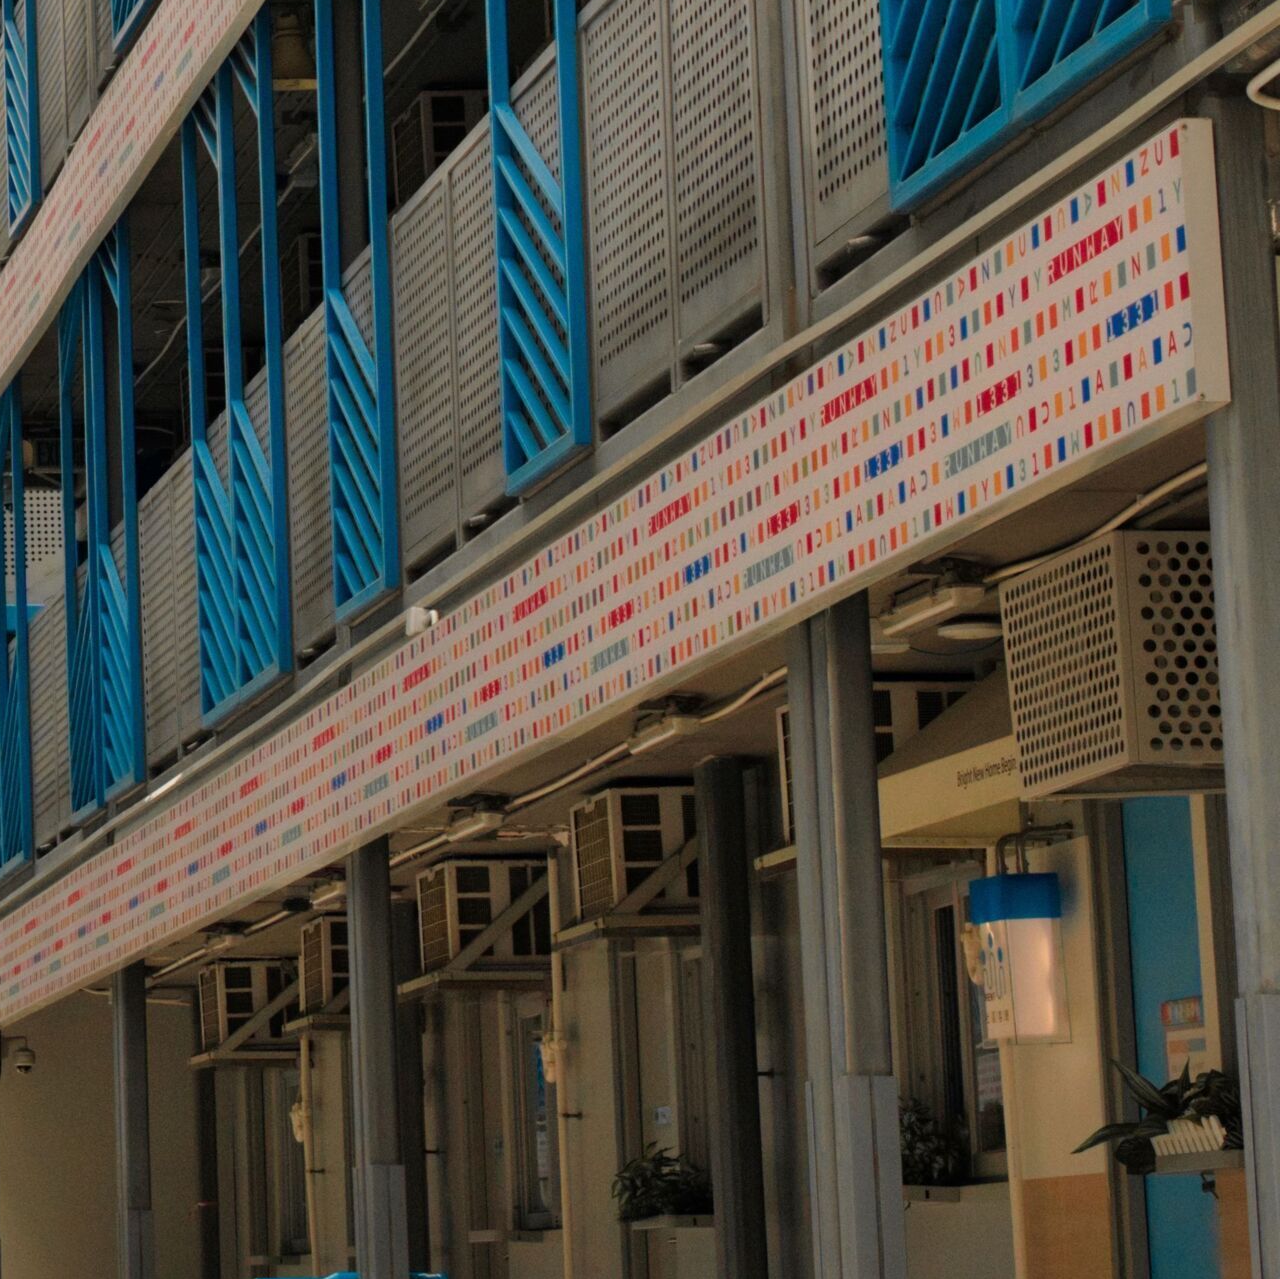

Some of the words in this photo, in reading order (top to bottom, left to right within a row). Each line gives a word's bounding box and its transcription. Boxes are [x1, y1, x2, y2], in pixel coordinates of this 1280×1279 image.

[511, 585, 548, 624] RUNWAY
[648, 491, 691, 537] RUNWAY
[819, 373, 877, 429] RUNWAY
[1046, 214, 1123, 286] RUNWAY
[682, 552, 712, 588] 1331
[767, 499, 801, 539] 1331
[864, 440, 903, 484] 1331
[976, 369, 1021, 417] 1331
[1106, 288, 1158, 343] 1331
[742, 543, 793, 591] RUNWAY
[944, 420, 1012, 480] RUNWAY
